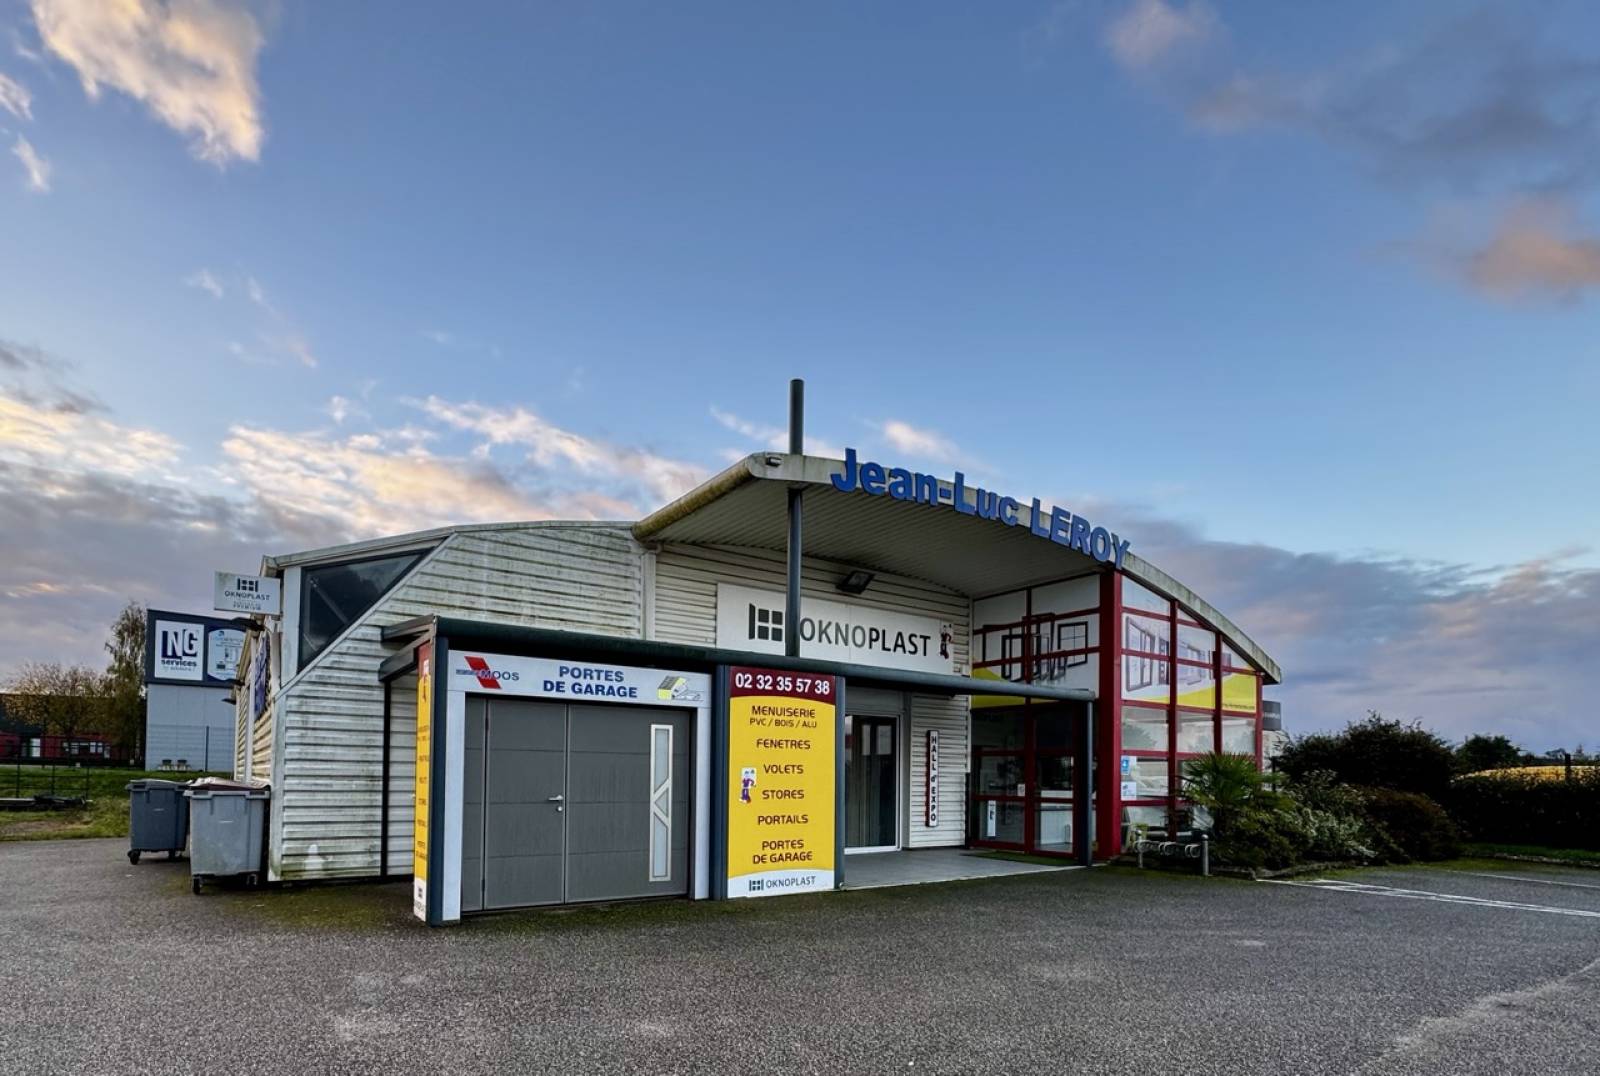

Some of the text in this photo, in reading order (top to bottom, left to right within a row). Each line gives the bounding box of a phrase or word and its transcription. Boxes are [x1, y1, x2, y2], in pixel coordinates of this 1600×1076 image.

[830, 447, 1130, 571] Jean-Luc LEROY
[224, 590, 271, 601] OKNOPLAST
[800, 617, 931, 657] OKNOPLAST
[161, 628, 200, 660] NG
[161, 659, 198, 668] services
[480, 669, 520, 681] MOOS
[559, 665, 625, 683] PORTES
[543, 680, 638, 698] DE GARAGE
[735, 673, 830, 695] 02 32 35 57 38
[751, 705, 816, 718] MENUISERIE
[749, 718, 767, 727] PVC
[774, 719, 794, 728] BOIS
[802, 720, 817, 728] ALU
[756, 738, 811, 750] FENETRES
[763, 763, 804, 774] VOLETS
[762, 789, 804, 800] STORES
[757, 814, 809, 825] PORTAILS
[762, 839, 804, 851] PORTES
[752, 851, 813, 865] DE GARAGE
[765, 875, 816, 889] OKNOPLAST
